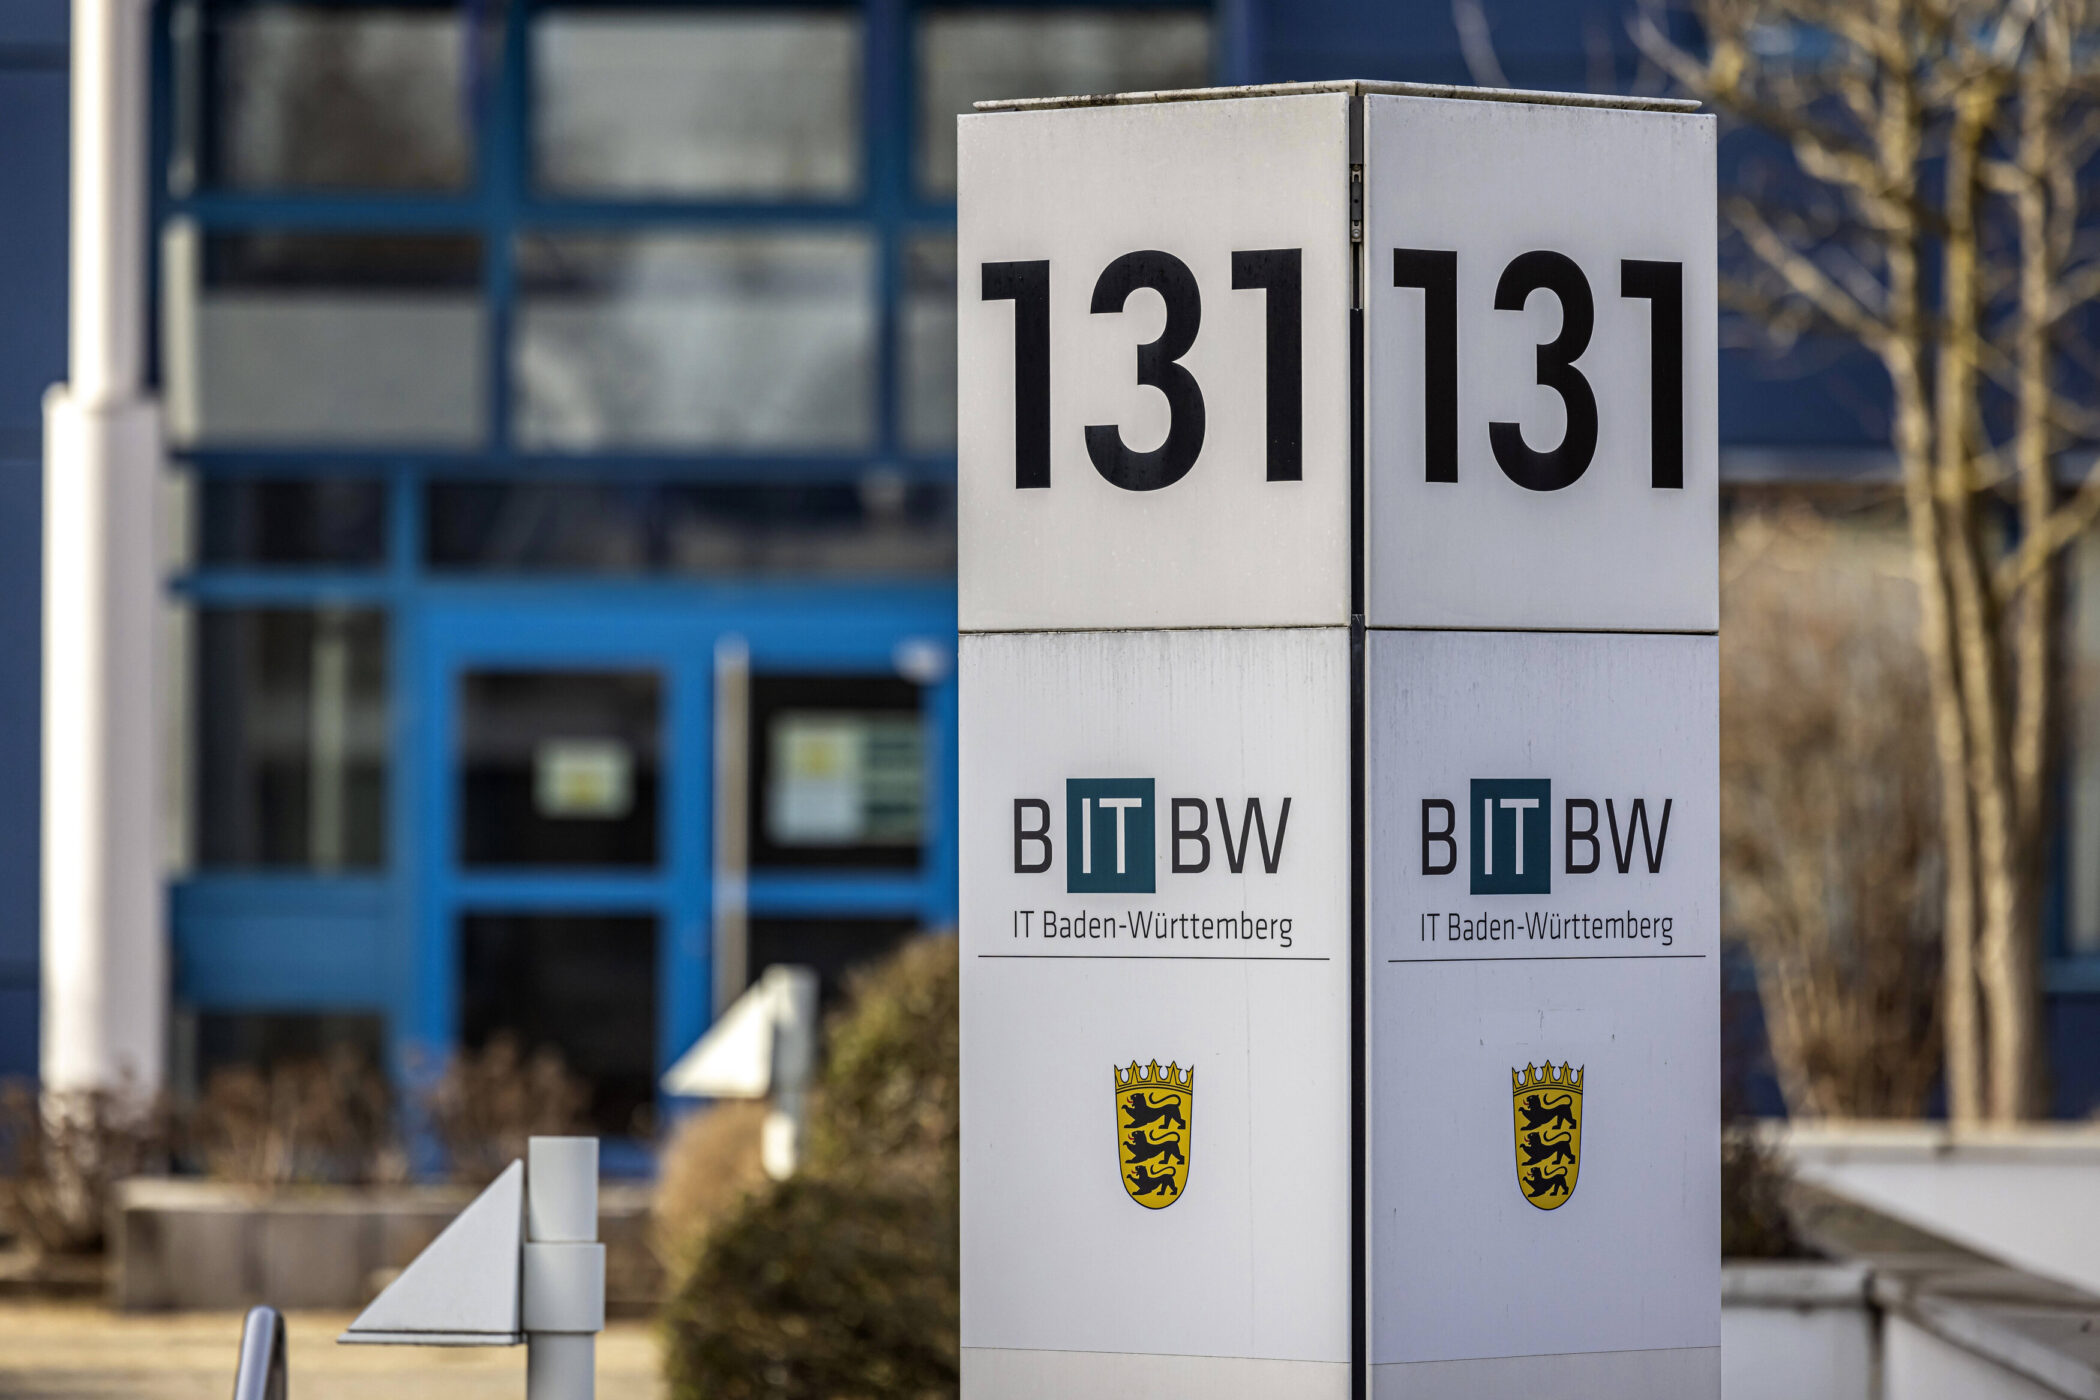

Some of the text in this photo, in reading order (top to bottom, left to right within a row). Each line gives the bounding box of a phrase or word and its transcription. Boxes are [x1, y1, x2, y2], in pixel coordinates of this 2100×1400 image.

[981, 247, 1303, 492] 131
[1393, 247, 1684, 492] 131
[1013, 797, 1292, 875] BITBW
[1421, 797, 1673, 876] BITBW
[1014, 909, 1293, 948] IT Baden-Württemberg
[1421, 909, 1674, 947] IT Baden-Württemberg
